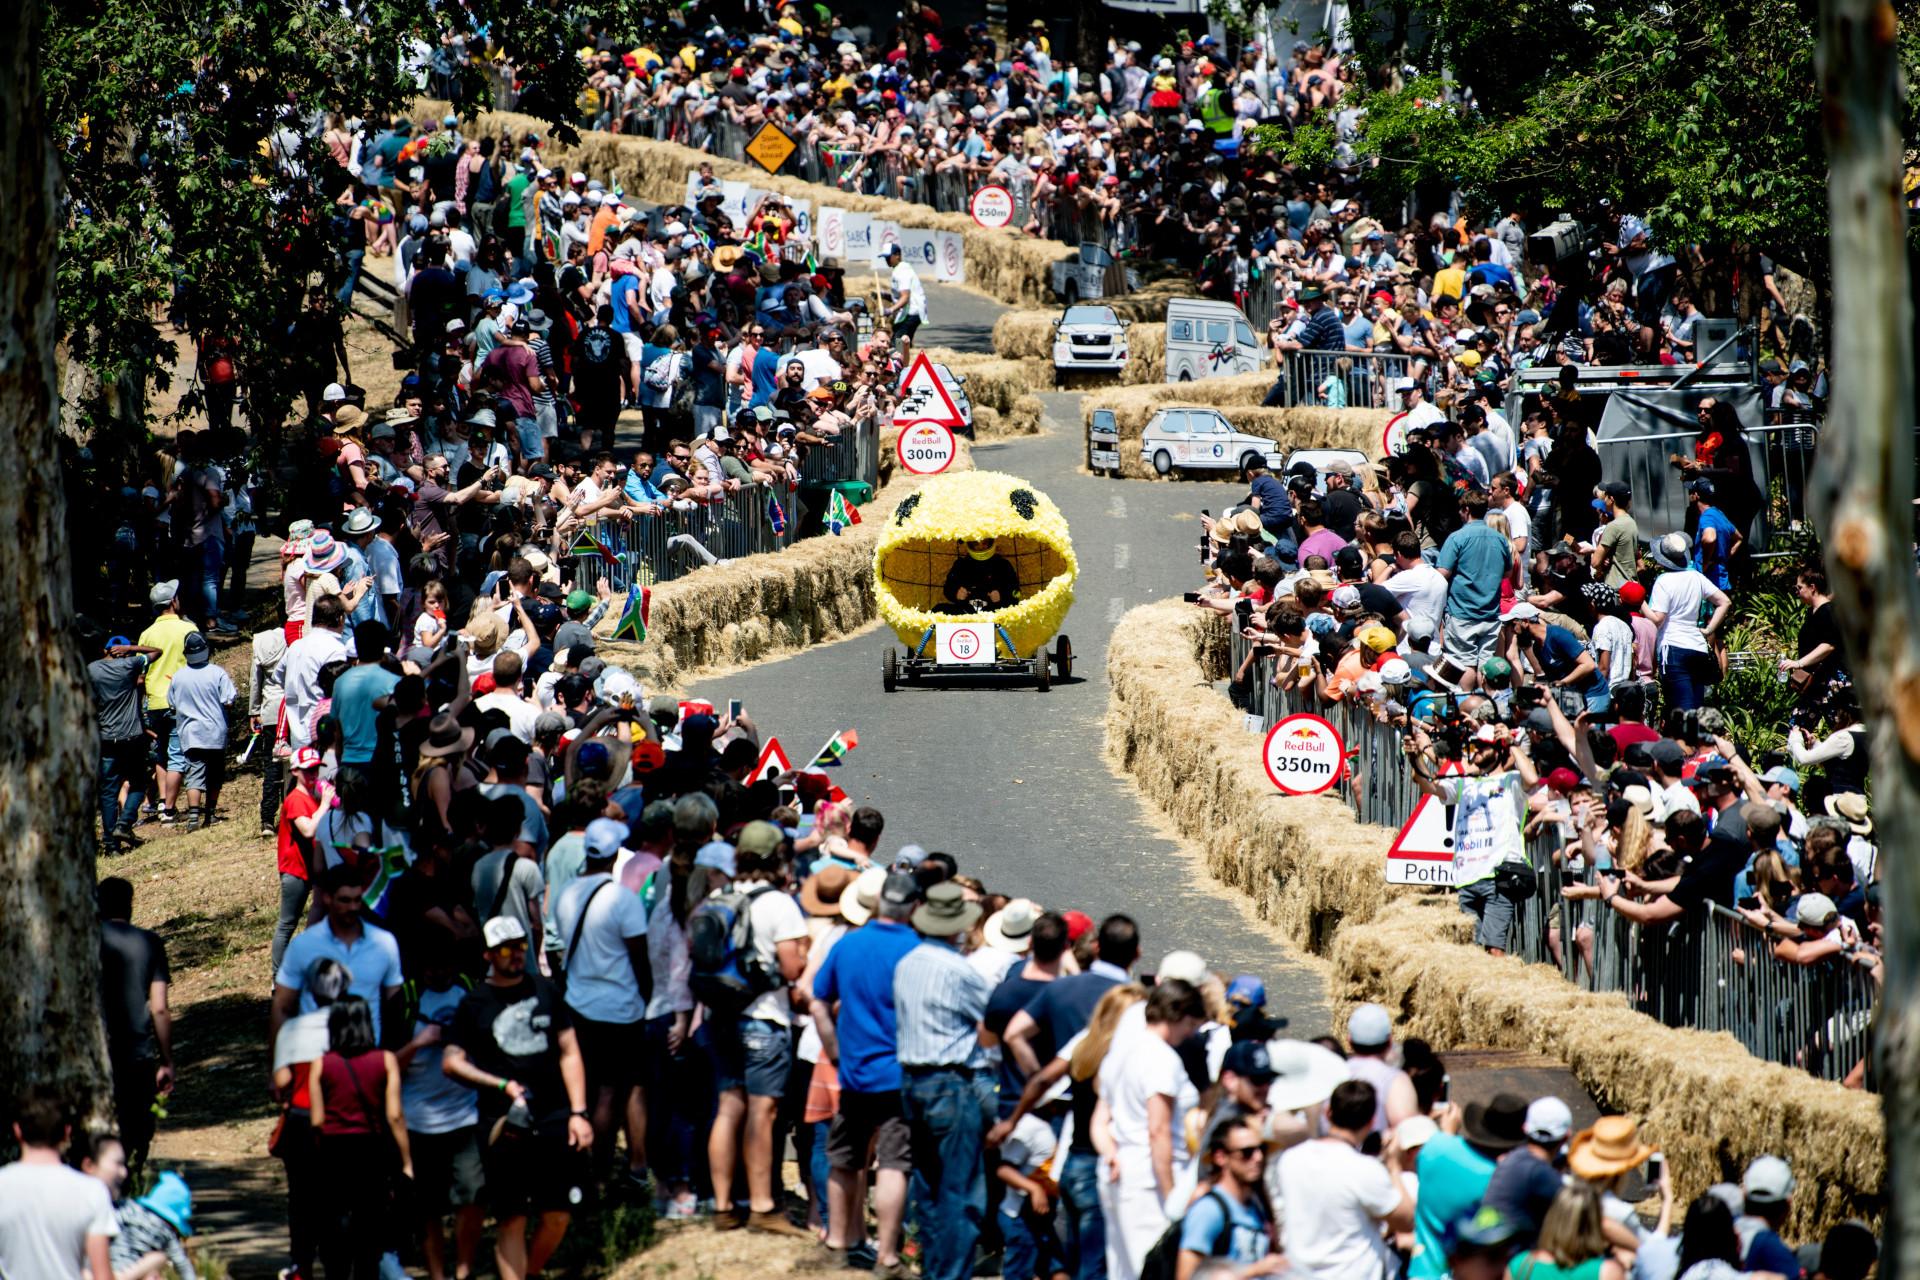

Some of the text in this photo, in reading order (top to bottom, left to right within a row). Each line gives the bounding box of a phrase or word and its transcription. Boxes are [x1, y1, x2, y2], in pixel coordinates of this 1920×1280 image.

[978, 208, 1007, 217] 250m
[912, 437, 941, 445] Red Bull
[907, 448, 947, 460] 300m
[960, 644, 970, 654] 18
[1284, 740, 1325, 753] Red Bull
[1276, 756, 1331, 774] 350m
[1457, 838, 1482, 851] Mobil
